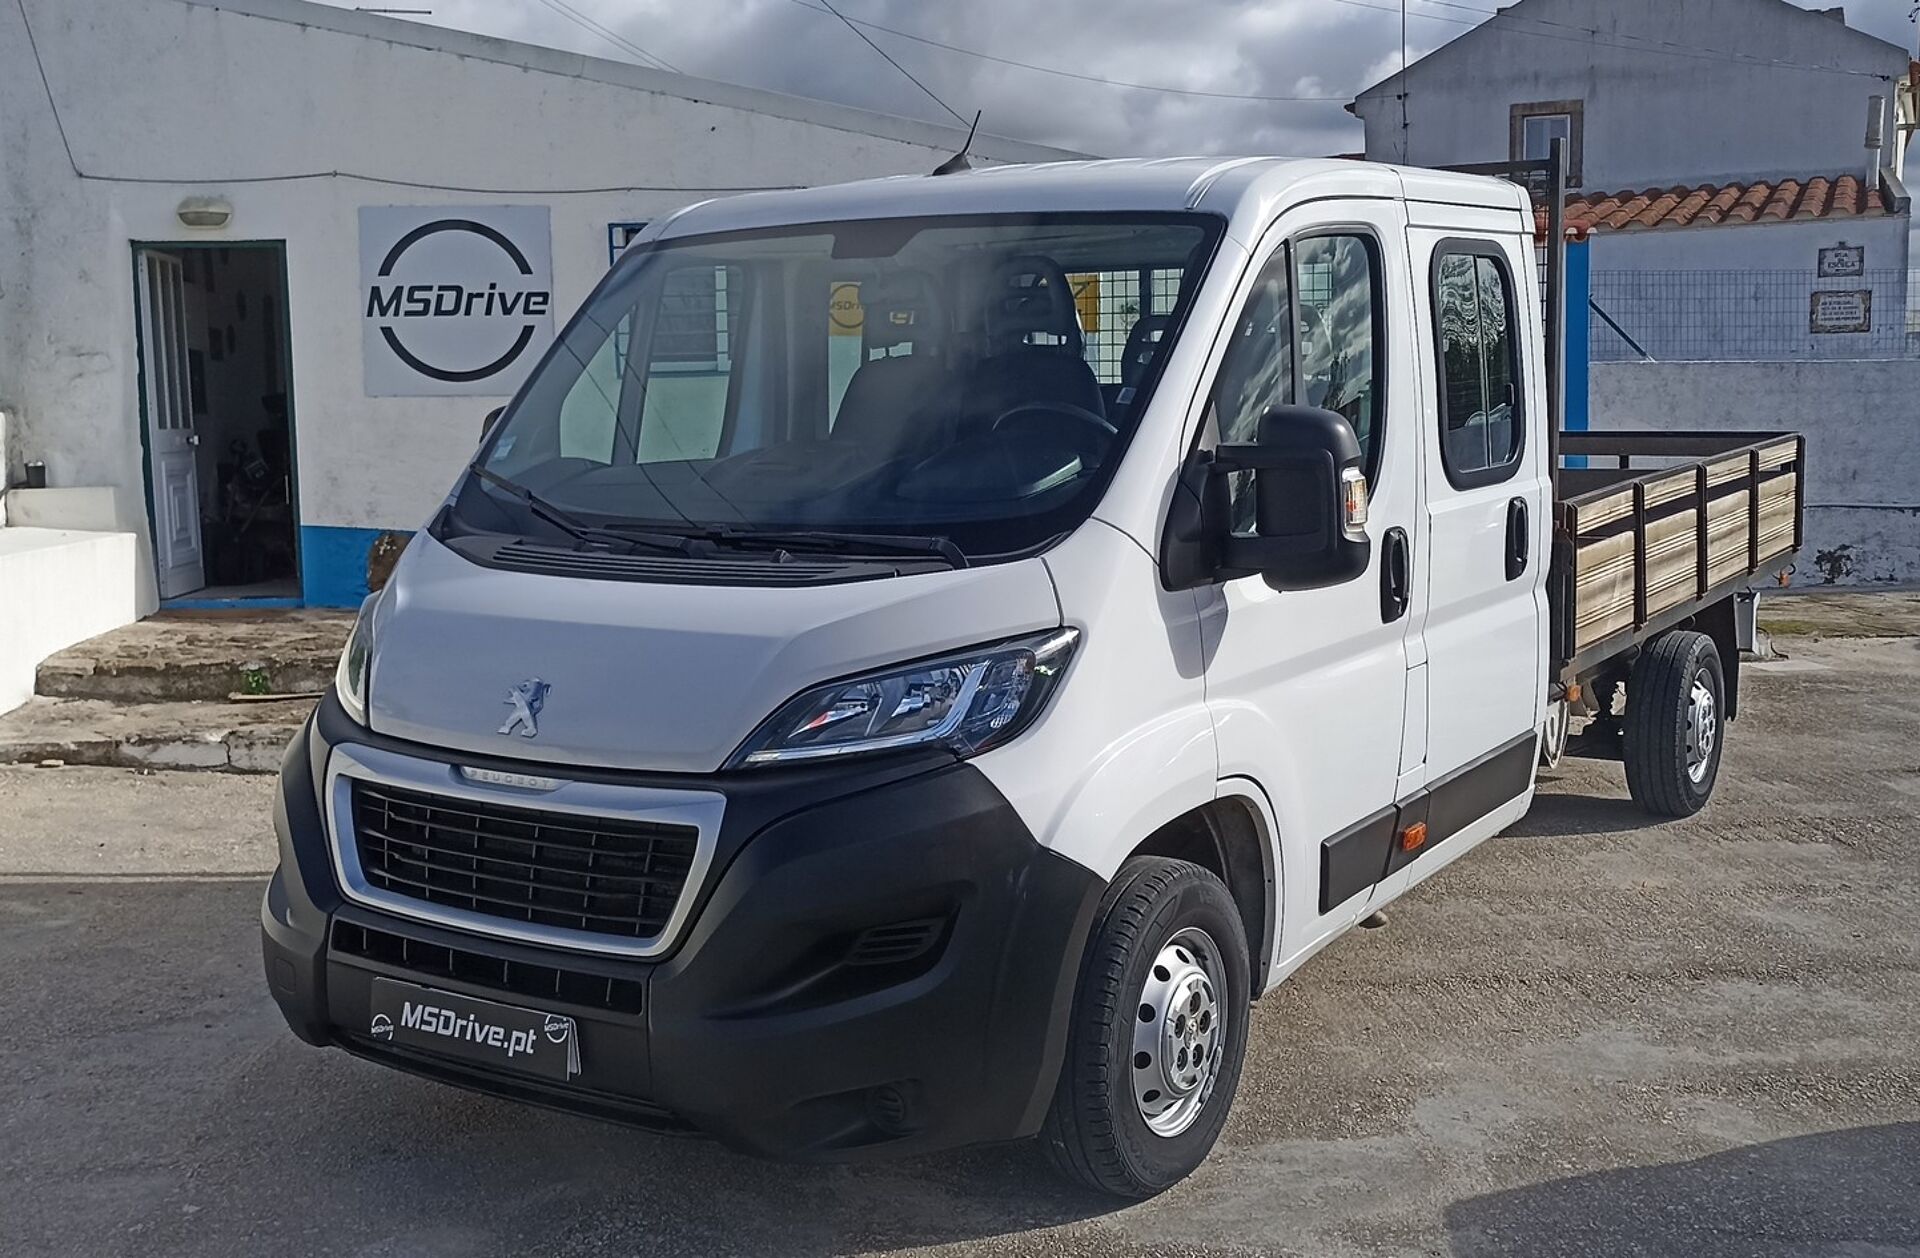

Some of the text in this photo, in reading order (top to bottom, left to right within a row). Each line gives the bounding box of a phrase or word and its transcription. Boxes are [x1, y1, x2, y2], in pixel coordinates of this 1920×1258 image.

[366, 282, 550, 318] MSDrive
[469, 769, 551, 790] PEUGEOT
[400, 1001, 538, 1058] MSDrive.pt
